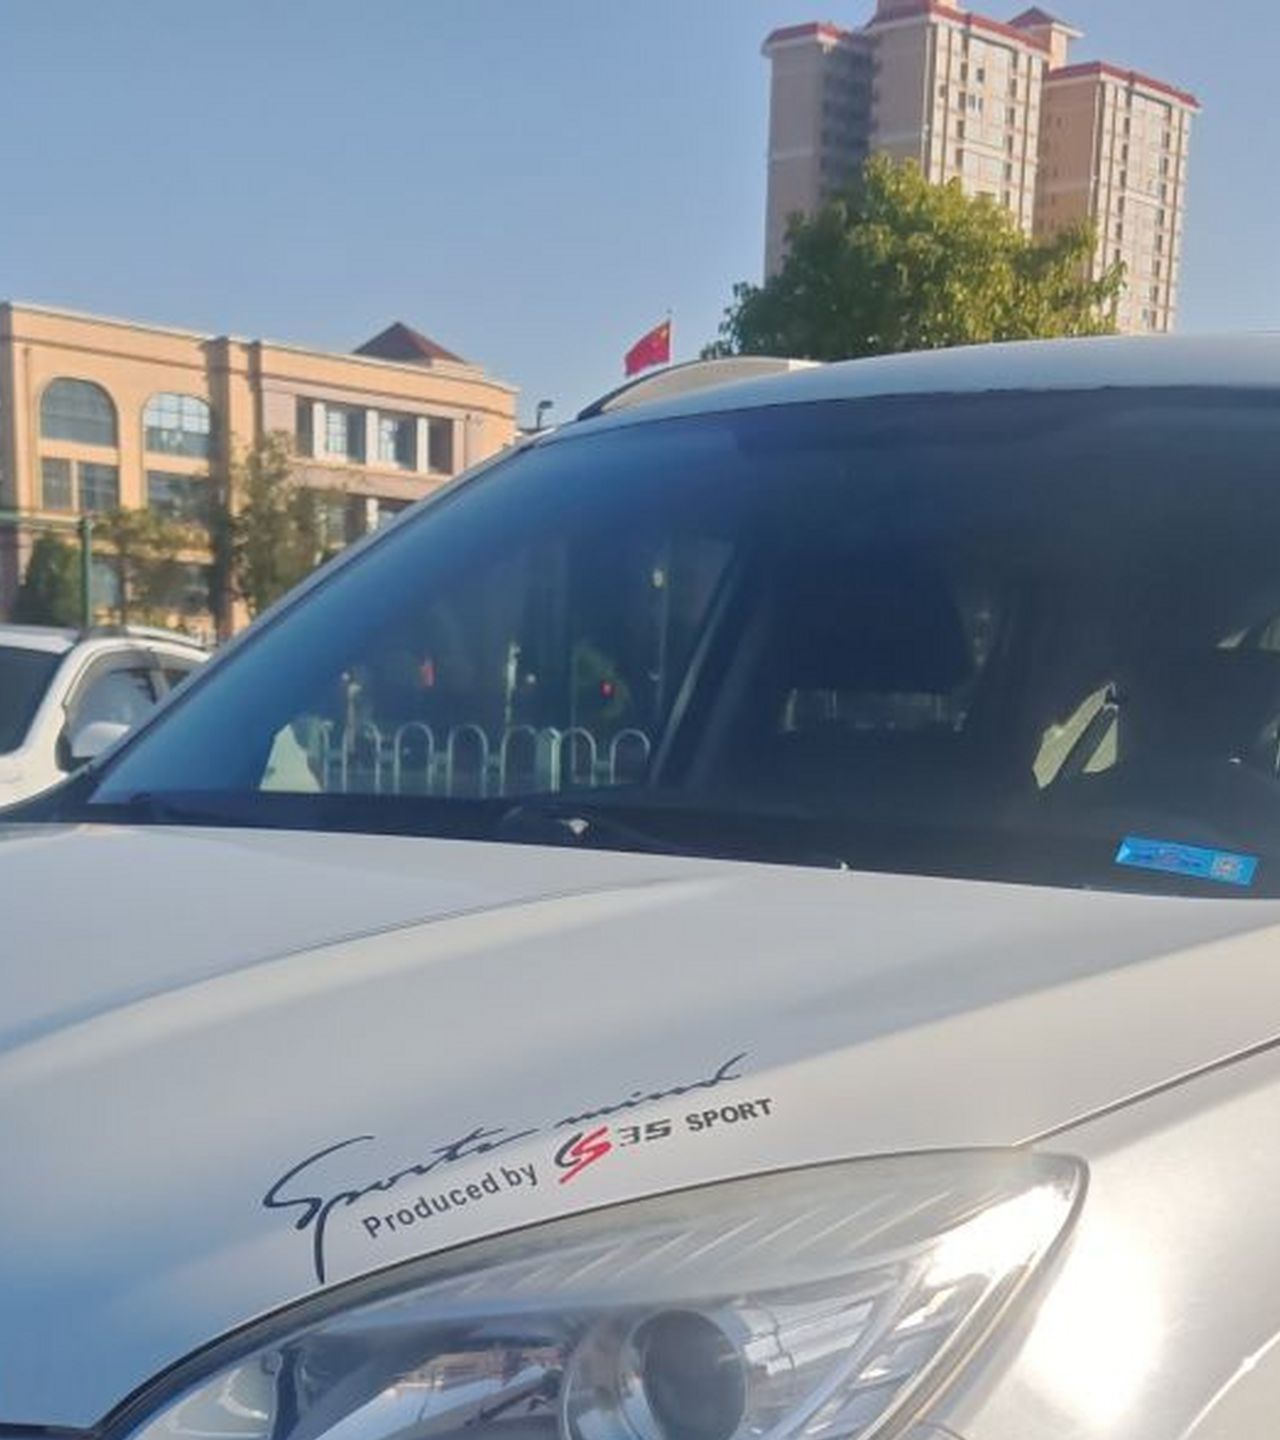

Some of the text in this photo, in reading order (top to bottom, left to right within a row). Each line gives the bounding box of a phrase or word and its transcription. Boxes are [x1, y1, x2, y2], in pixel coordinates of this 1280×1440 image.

[362, 1171, 501, 1240] Produced
[500, 1163, 539, 1190] by
[685, 1098, 772, 1132] SPORT
